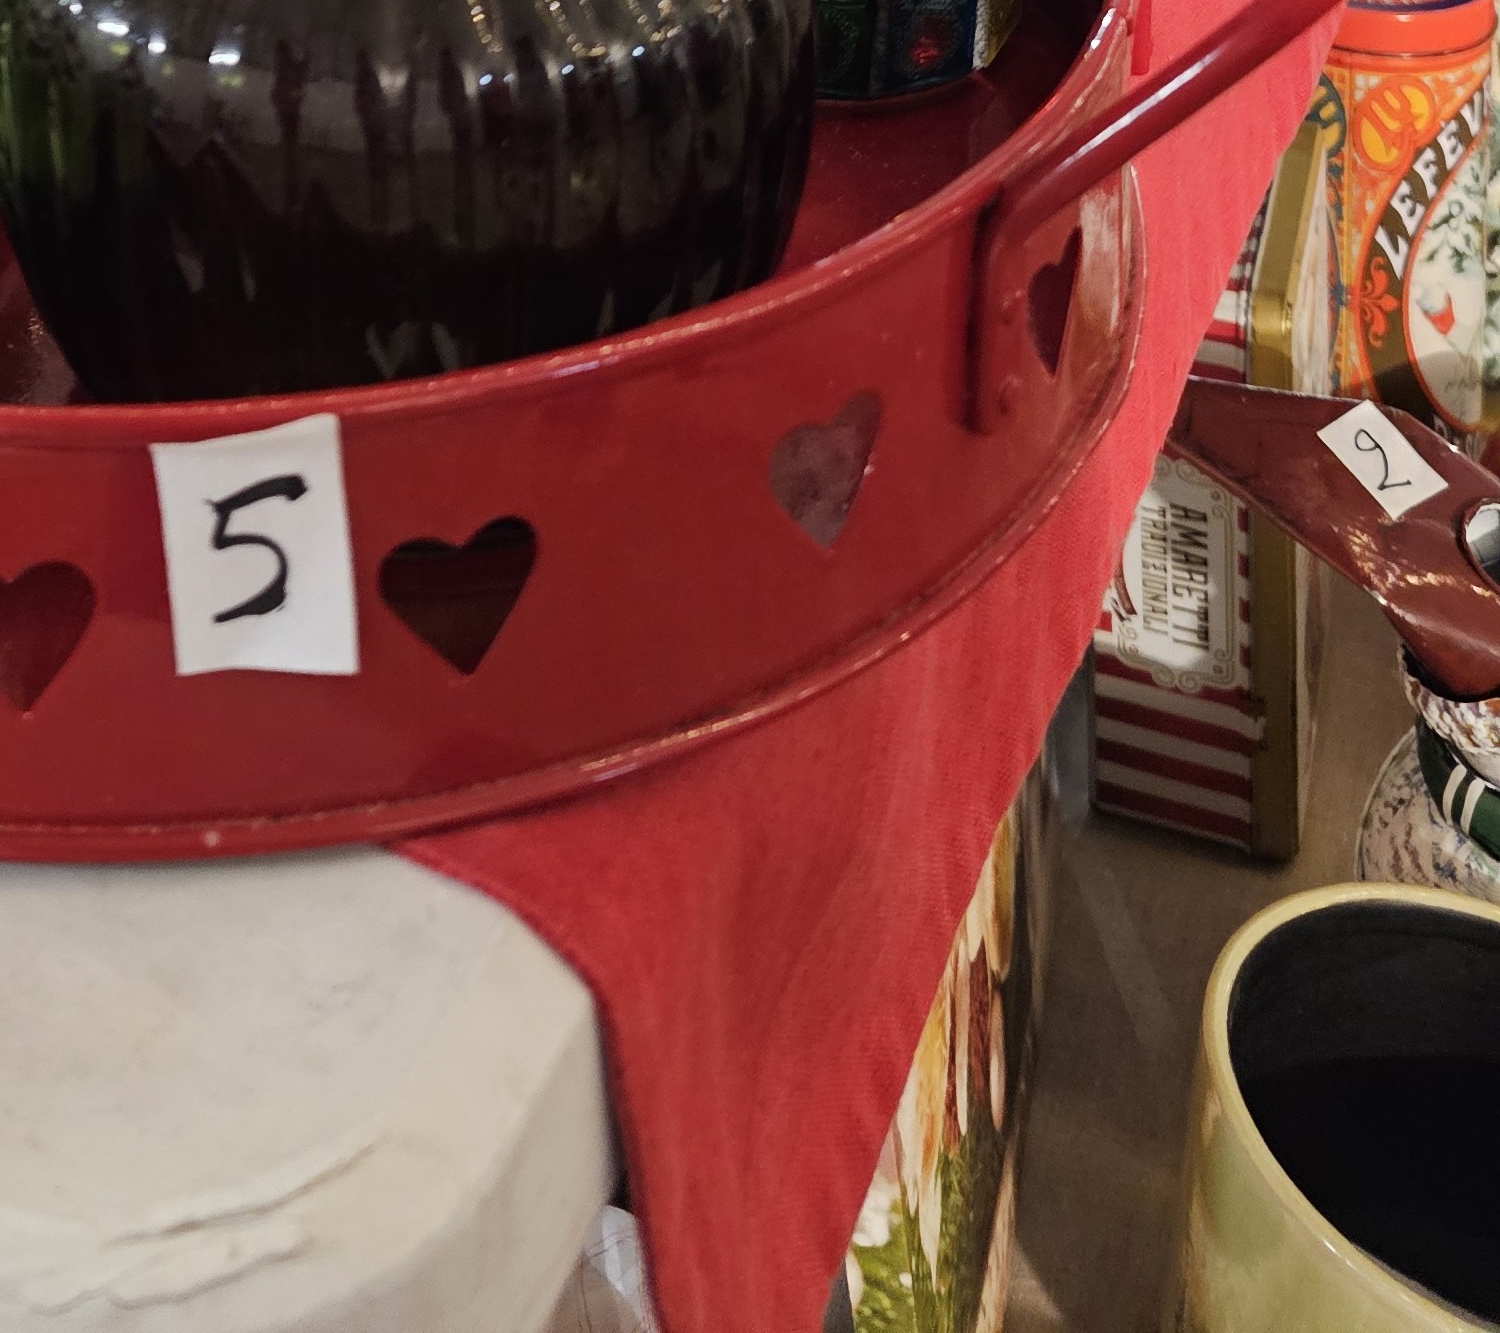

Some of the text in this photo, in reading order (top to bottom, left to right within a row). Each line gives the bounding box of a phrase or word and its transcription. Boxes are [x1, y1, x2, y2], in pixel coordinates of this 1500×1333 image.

[1354, 428, 1412, 491] 2
[204, 473, 308, 624] 5
[1140, 504, 1168, 637] TRADIZIONALI
[1168, 502, 1210, 651] AMARETTI
